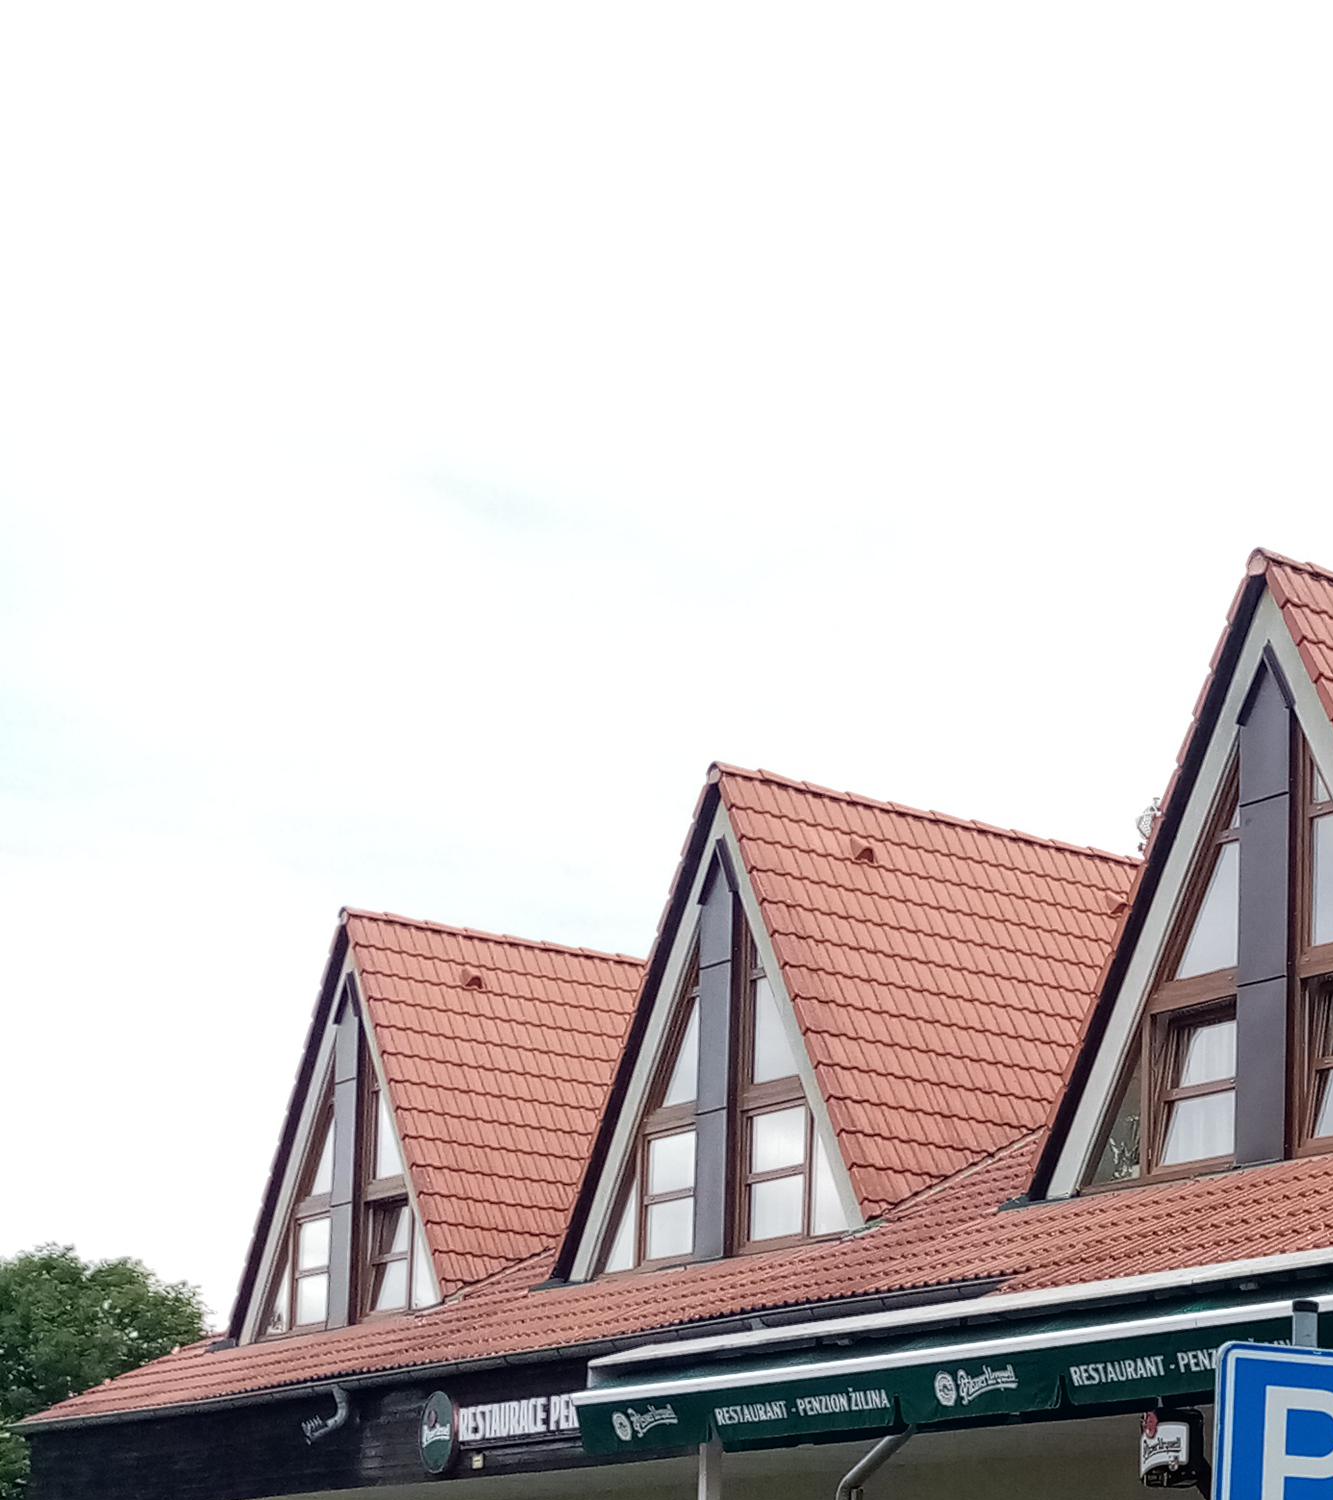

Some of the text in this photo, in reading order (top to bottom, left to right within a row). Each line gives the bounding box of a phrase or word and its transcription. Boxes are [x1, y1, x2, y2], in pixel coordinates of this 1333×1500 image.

[1069, 1355, 1165, 1387] RESTAURANT
[1176, 1347, 1219, 1373] PENZ
[458, 1397, 547, 1441] RESTAURACE
[714, 1400, 787, 1427] RESTAURANT
[797, 1392, 848, 1416] PENZION
[848, 1387, 890, 1412] ŽILINA
